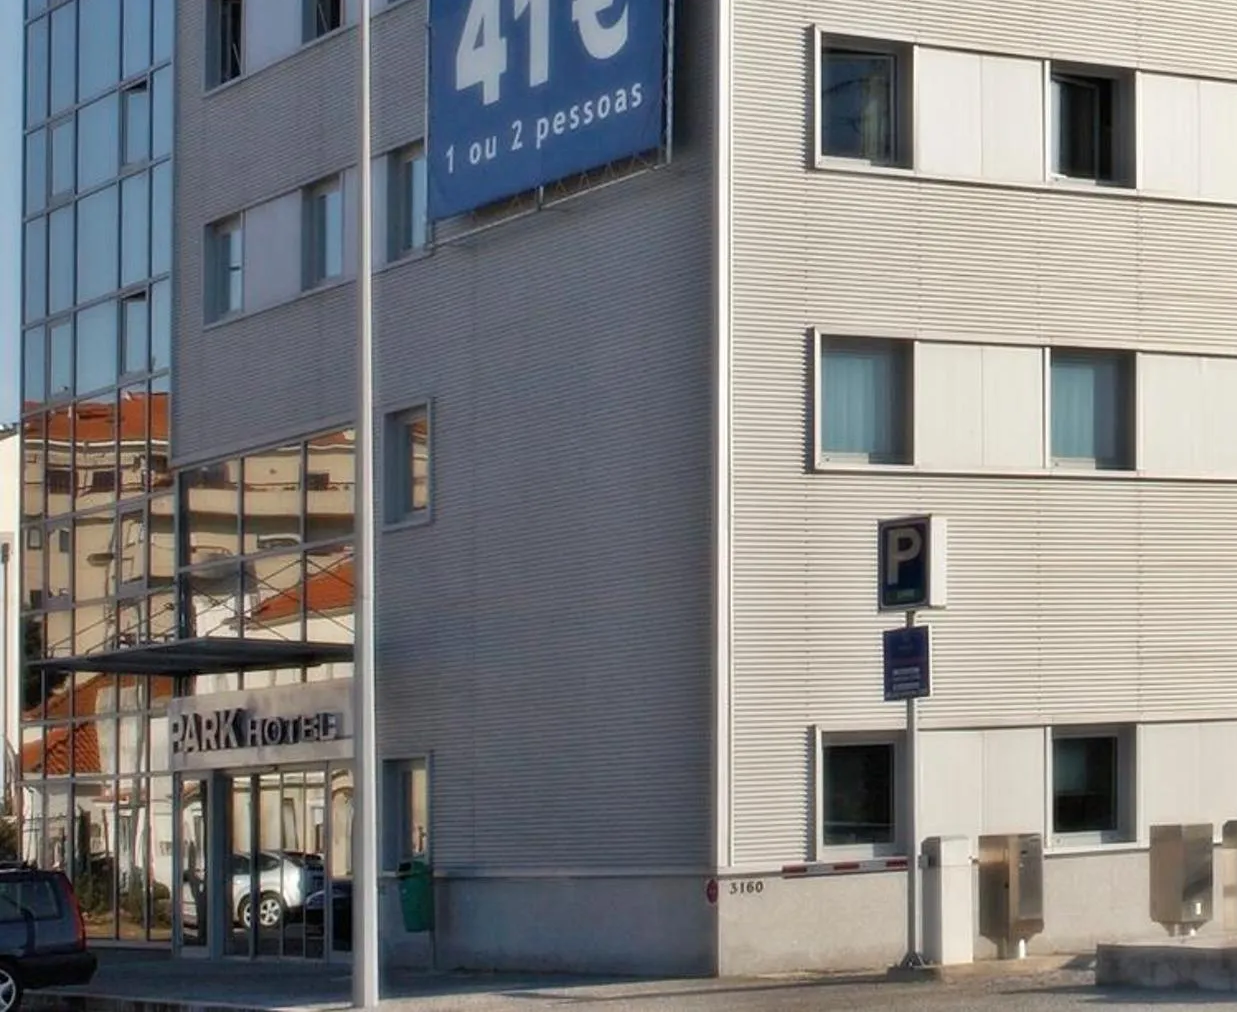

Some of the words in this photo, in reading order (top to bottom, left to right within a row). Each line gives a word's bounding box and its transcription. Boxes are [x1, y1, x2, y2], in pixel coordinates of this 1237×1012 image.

[446, 145, 454, 173] 1
[469, 135, 497, 165] ou
[511, 120, 522, 151] 2
[536, 83, 643, 149] pessoas
[887, 527, 922, 586] P
[171, 708, 240, 754] PARK
[248, 714, 336, 747] HOTEL
[730, 881, 764, 895] 3160
